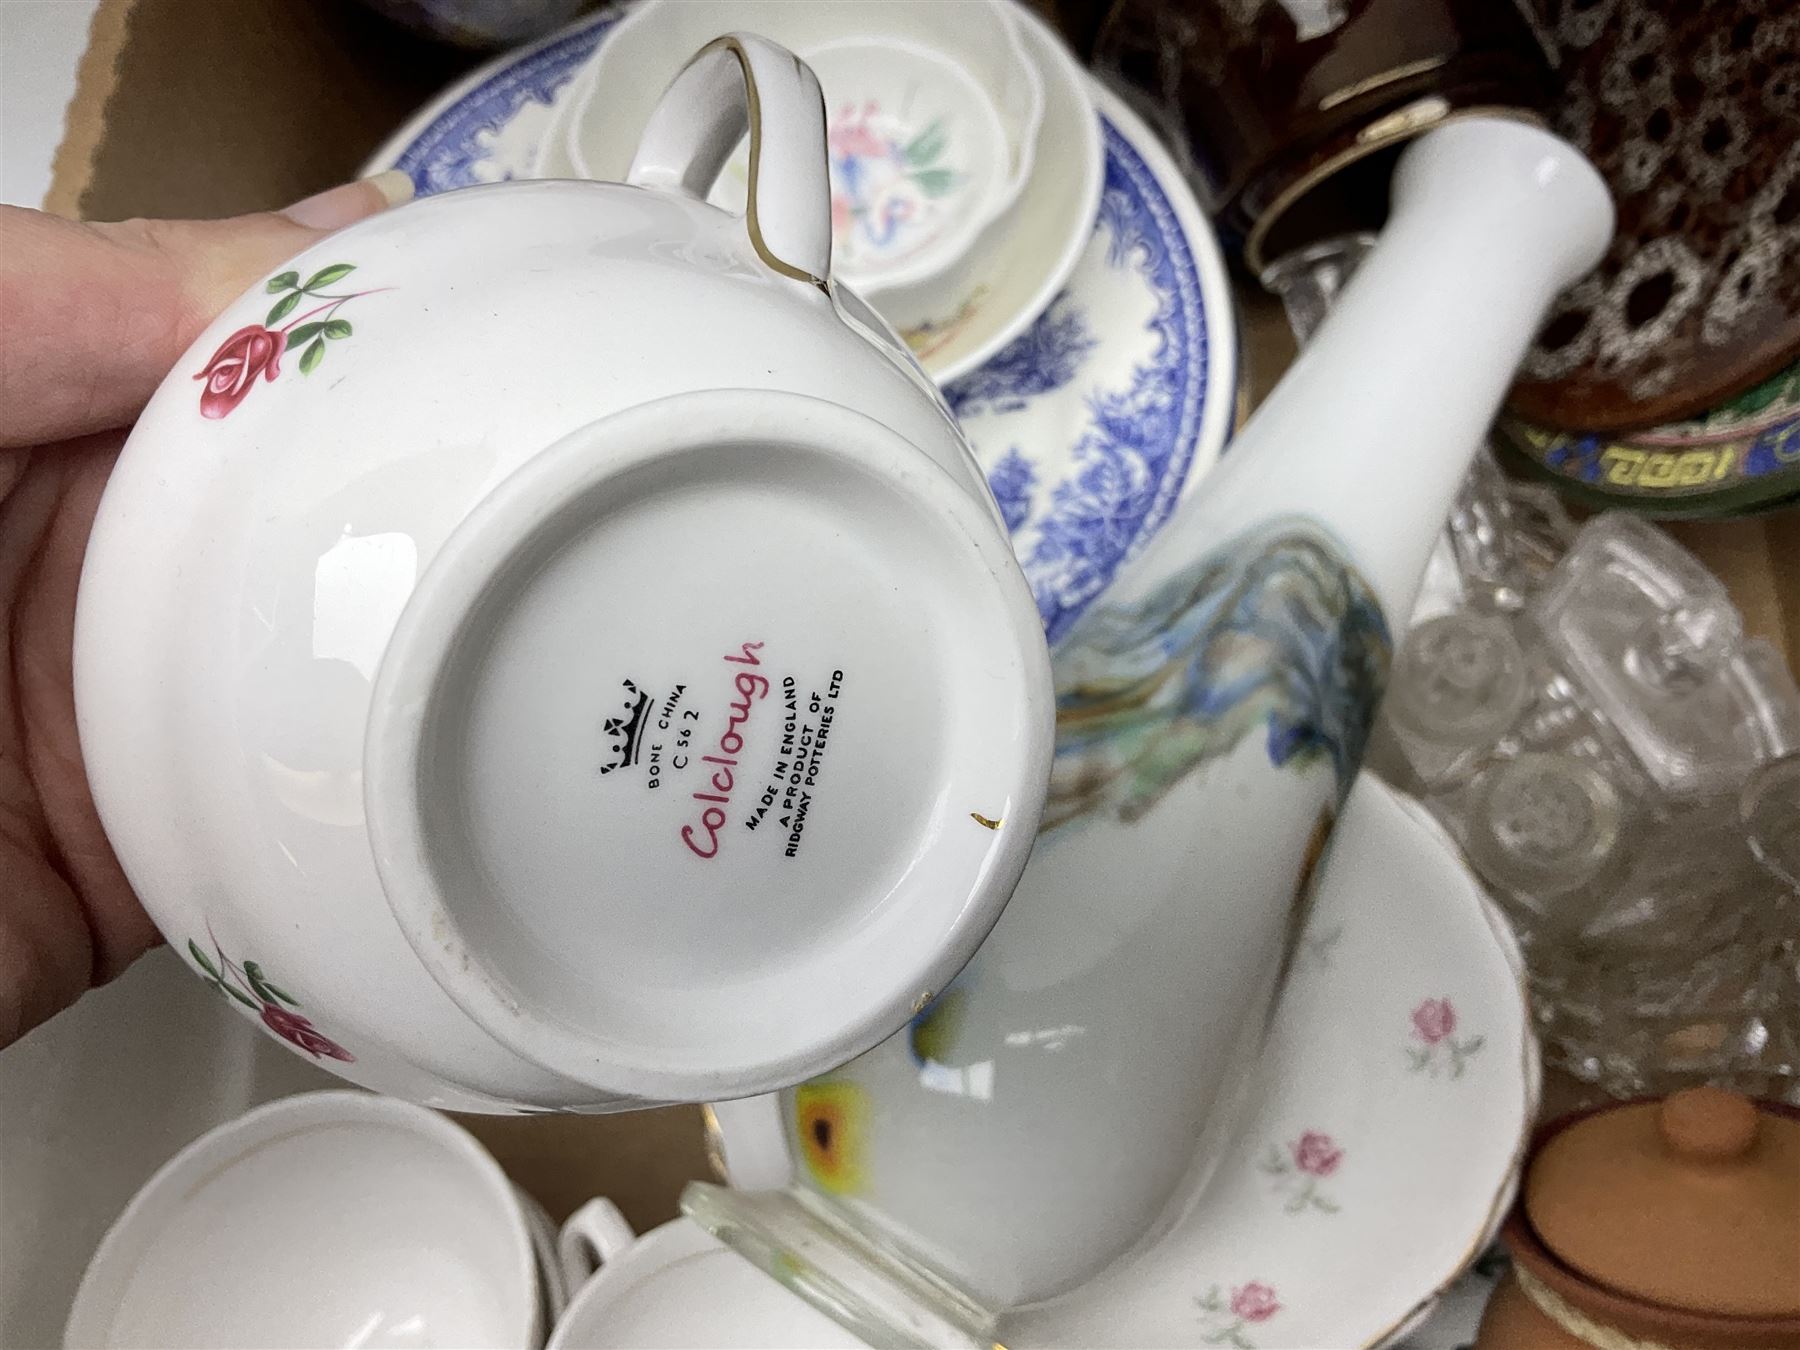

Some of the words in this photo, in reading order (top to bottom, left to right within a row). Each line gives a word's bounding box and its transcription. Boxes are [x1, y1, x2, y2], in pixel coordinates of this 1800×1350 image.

[648, 744, 663, 788] BONE
[658, 685, 687, 730] CHINA
[780, 676, 797, 755] ENGLAND
[809, 692, 821, 713] OF
[681, 641, 769, 859] Colclough
[773, 761, 788, 780] IN
[783, 724, 814, 810] PRODUCT
[785, 791, 812, 858] RIDGWAY
[804, 706, 834, 786] POTTERIES
[828, 669, 844, 699] LTD
[745, 785, 778, 831] MADE
[779, 816, 791, 828] A
